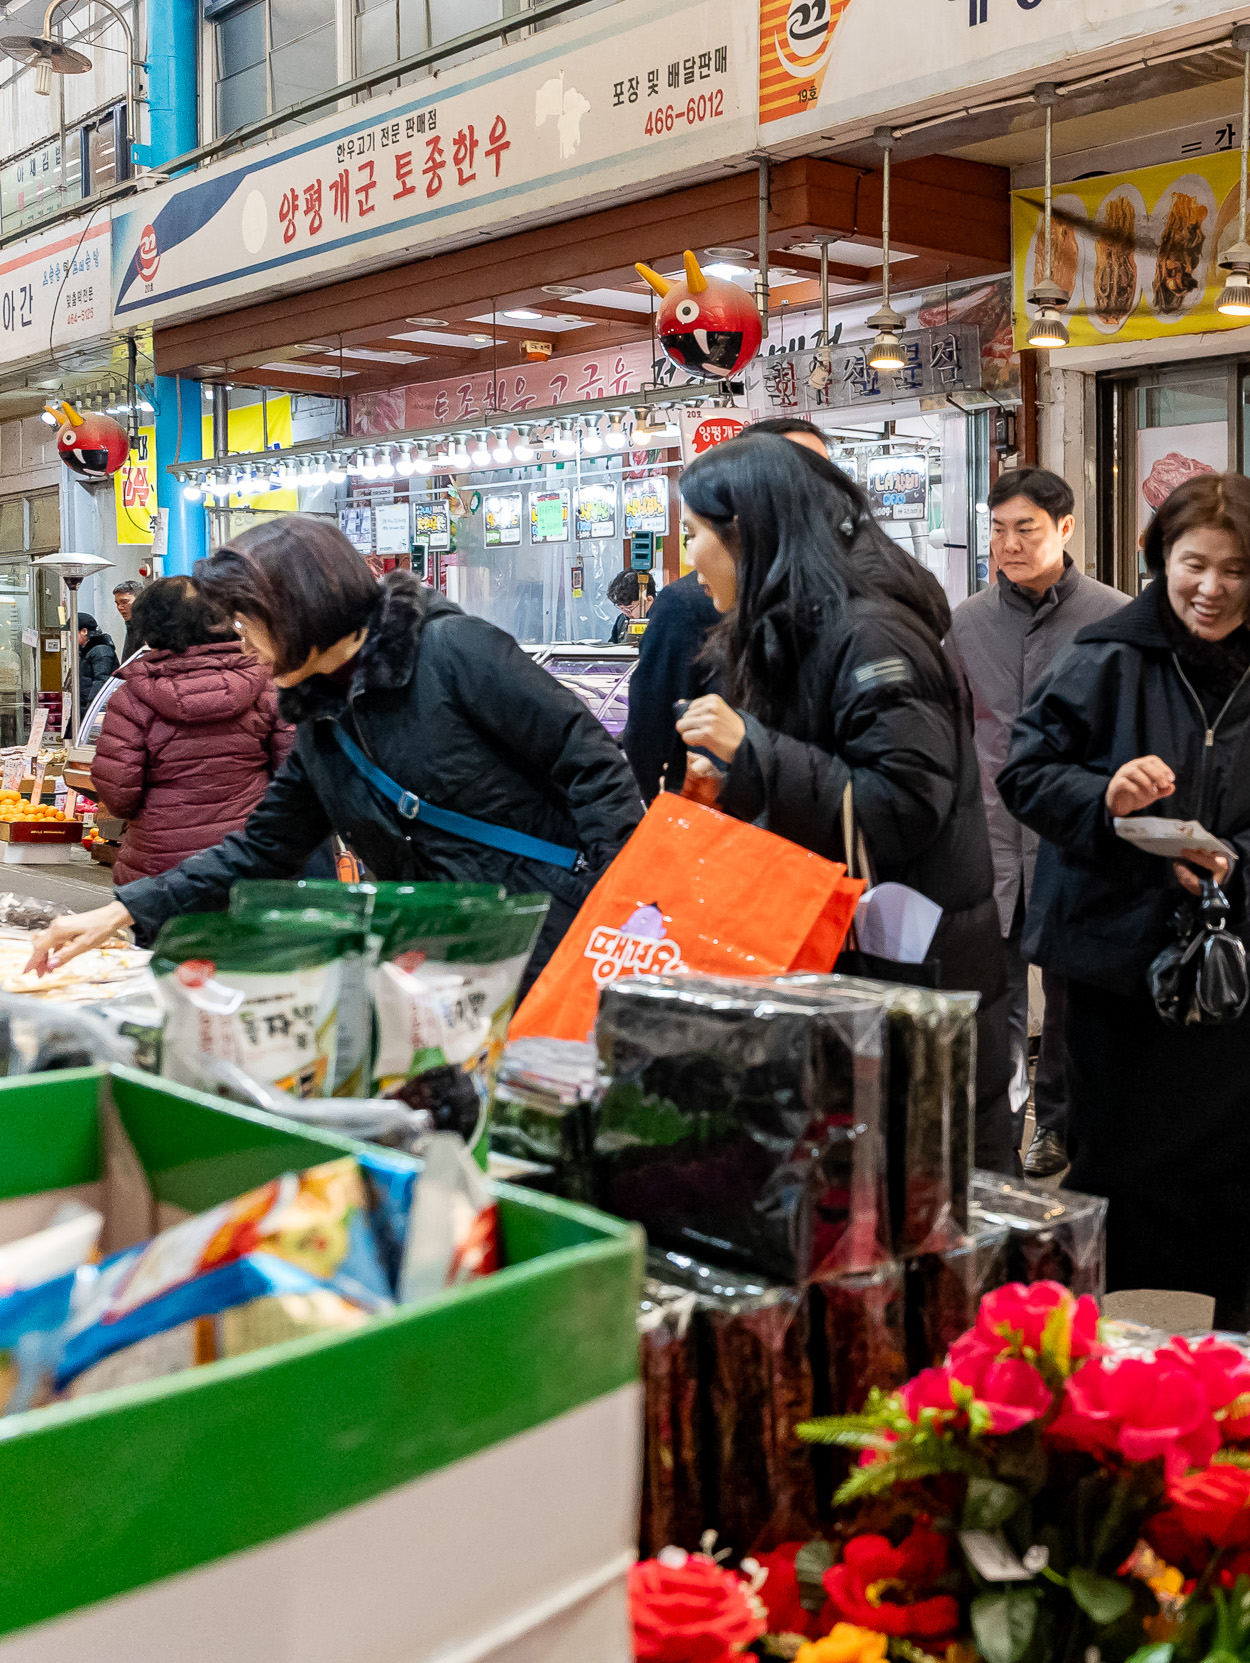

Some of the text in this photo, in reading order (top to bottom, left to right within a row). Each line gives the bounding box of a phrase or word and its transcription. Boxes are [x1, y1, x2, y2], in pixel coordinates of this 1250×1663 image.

[612, 45, 728, 107] 포장 및 배달판매
[797, 85, 818, 104] 19호
[336, 108, 437, 164] 한우고기 전문 판매점
[644, 88, 724, 137] 466-6012
[278, 114, 511, 245] 양평개군 토종한우
